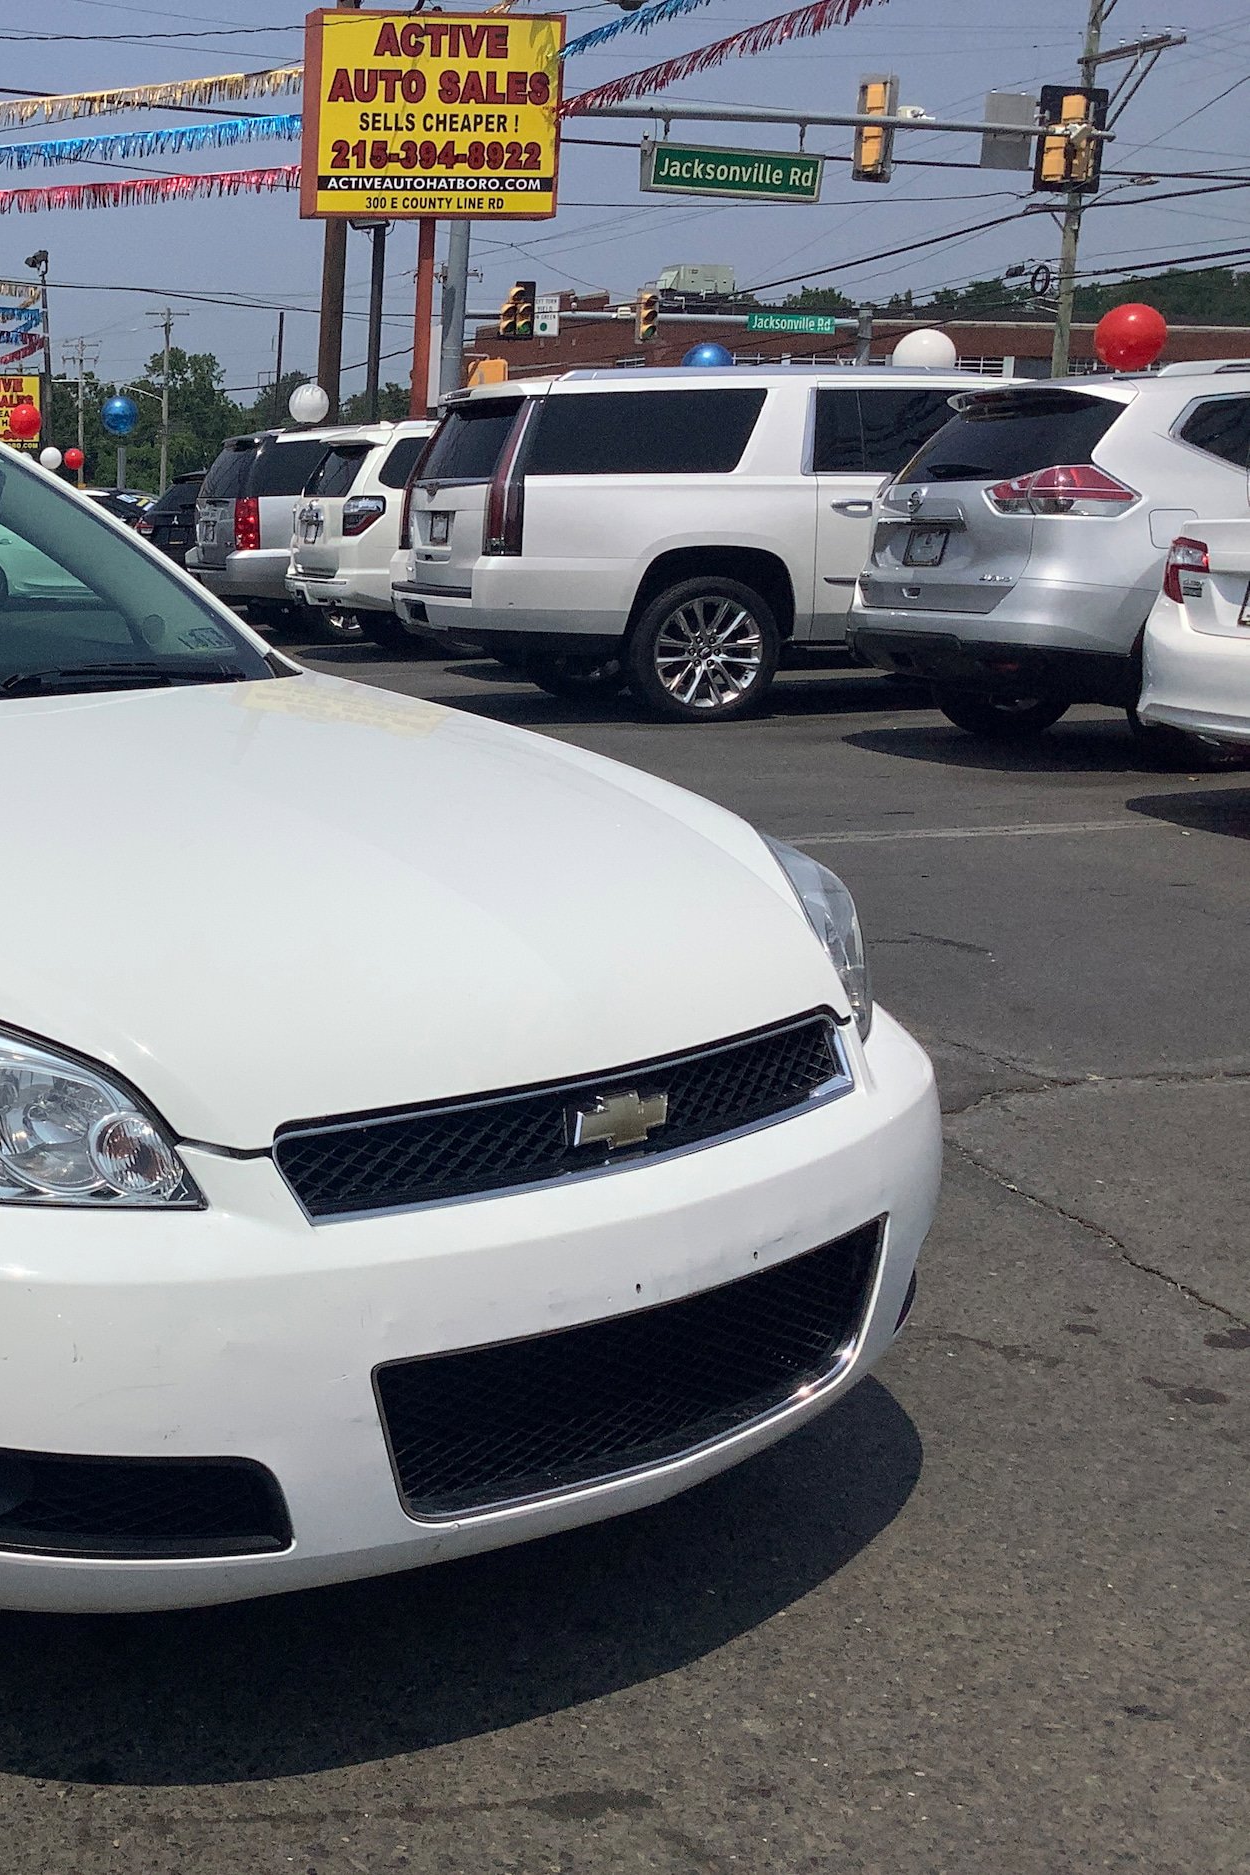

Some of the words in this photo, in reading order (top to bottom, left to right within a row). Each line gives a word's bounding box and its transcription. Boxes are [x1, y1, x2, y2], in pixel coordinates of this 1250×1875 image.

[374, 23, 508, 58] ACTIVE
[327, 68, 426, 103] AUTO
[438, 71, 550, 105] SALES
[359, 113, 415, 132] SELLS
[423, 114, 507, 133] CHEAPER
[331, 140, 541, 170] 215-394-8922
[327, 177, 541, 191] ACTIVEAUTOHATBORO.COM
[659, 158, 783, 185] Jacksonville
[789, 167, 814, 187] Rd
[365, 197, 387, 209] 300
[391, 198, 398, 209] E
[402, 198, 453, 209] COUNTY
[457, 198, 485, 209] LINE
[488, 198, 504, 209] RD
[752, 315, 815, 331] Jacksonville
[817, 317, 831, 331] Rd
